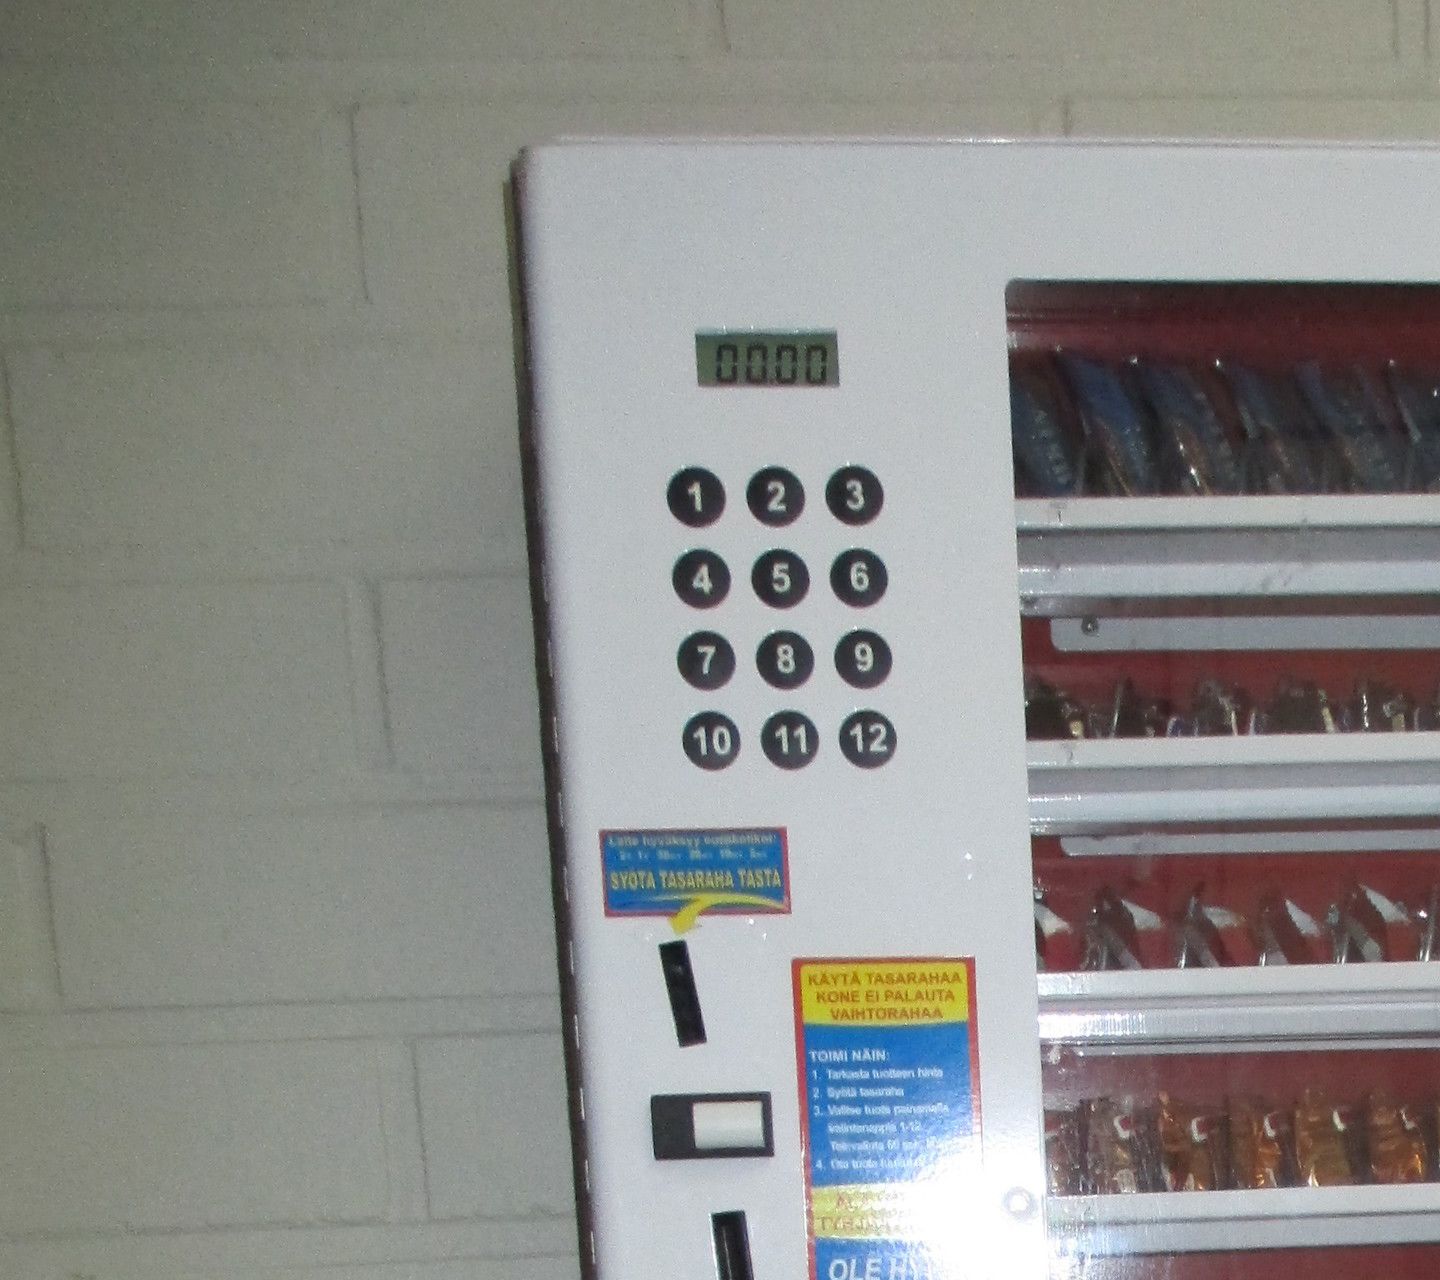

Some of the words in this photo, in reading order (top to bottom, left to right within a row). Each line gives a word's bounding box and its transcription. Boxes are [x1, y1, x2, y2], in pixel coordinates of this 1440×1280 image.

[716, 342, 828, 385] 0000
[687, 483, 703, 513] 1
[766, 481, 787, 512] 2
[845, 479, 866, 509] 3
[692, 564, 713, 596] 4
[772, 564, 792, 594] 5
[849, 562, 870, 592] 6
[696, 644, 717, 675] 7
[776, 644, 797, 674] 8
[854, 641, 875, 672] 9
[693, 725, 732, 756] 10
[774, 725, 808, 756] 11
[849, 723, 888, 754] 12
[866, 970, 963, 986] TASARAHAA
[815, 989, 861, 1004] KONE
[864, 989, 881, 1004] EI
[883, 988, 956, 1004] PALAUTA
[830, 1006, 944, 1021] VAIHTORAHAA
[808, 1048, 849, 1063] TOIMI
